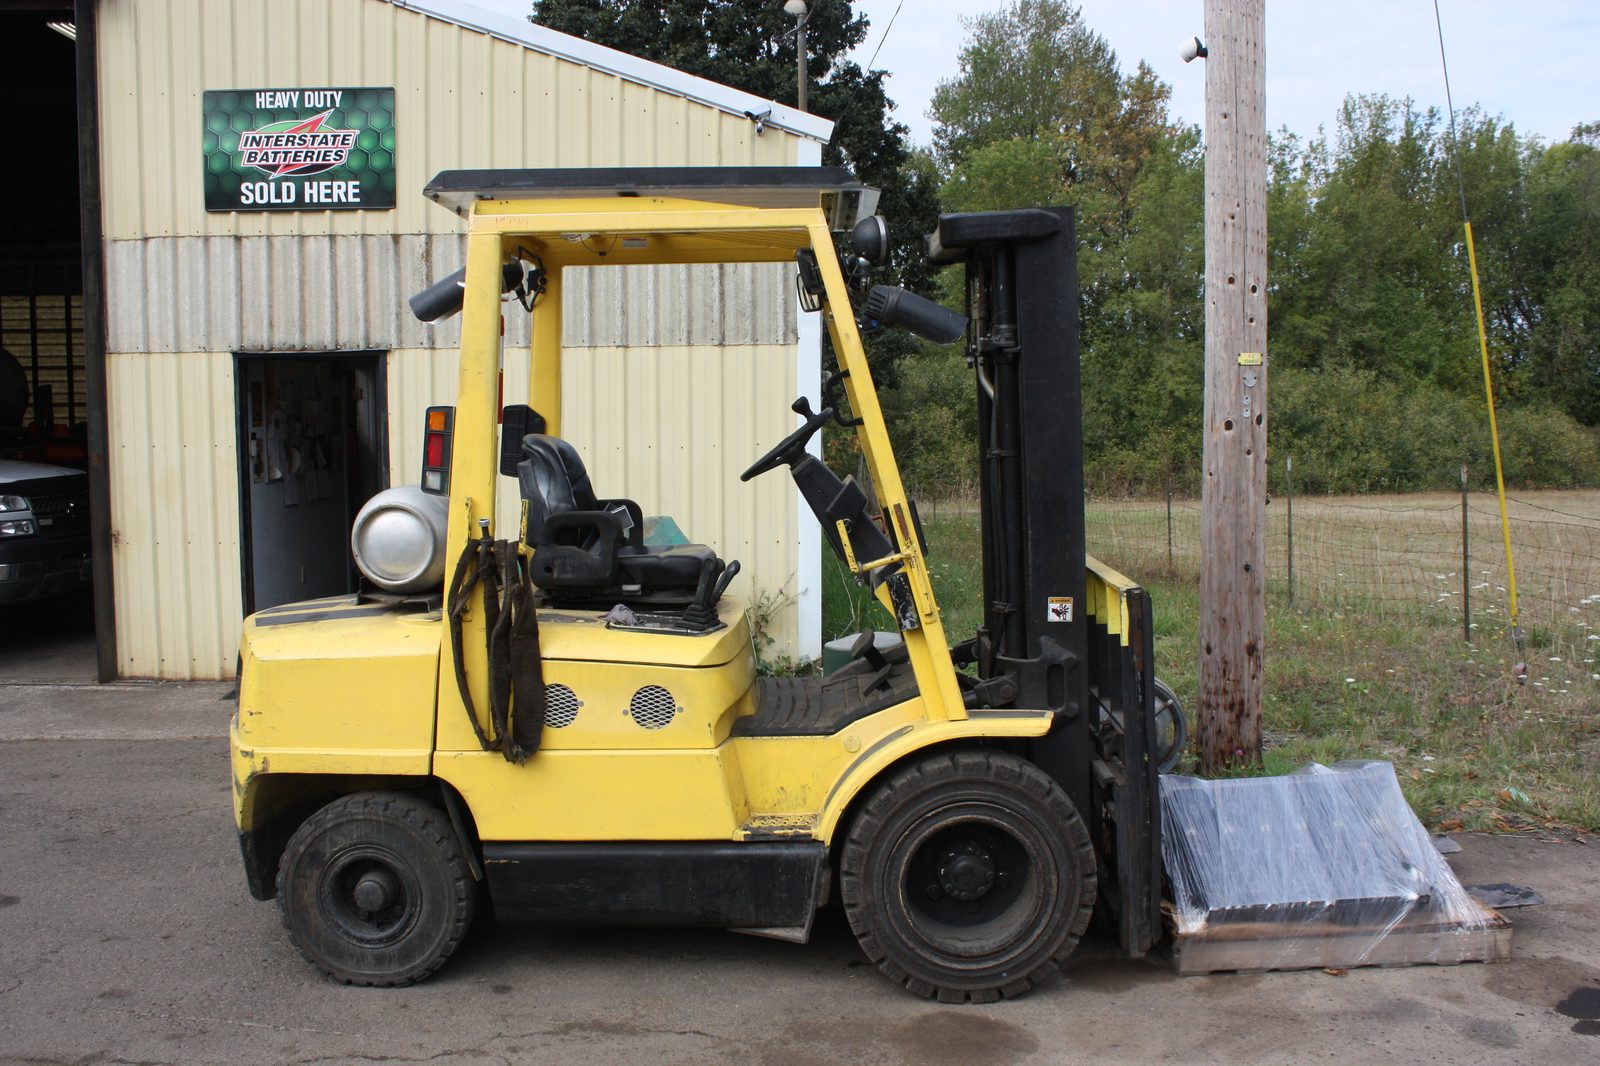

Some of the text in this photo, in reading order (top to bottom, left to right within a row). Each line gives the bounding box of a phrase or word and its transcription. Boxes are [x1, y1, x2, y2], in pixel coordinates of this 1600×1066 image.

[255, 90, 343, 109] HEAVY DUTY
[242, 133, 352, 148] INTERSTATE
[246, 149, 346, 164] BATTERIES
[240, 180, 361, 204] SOLD HERE
